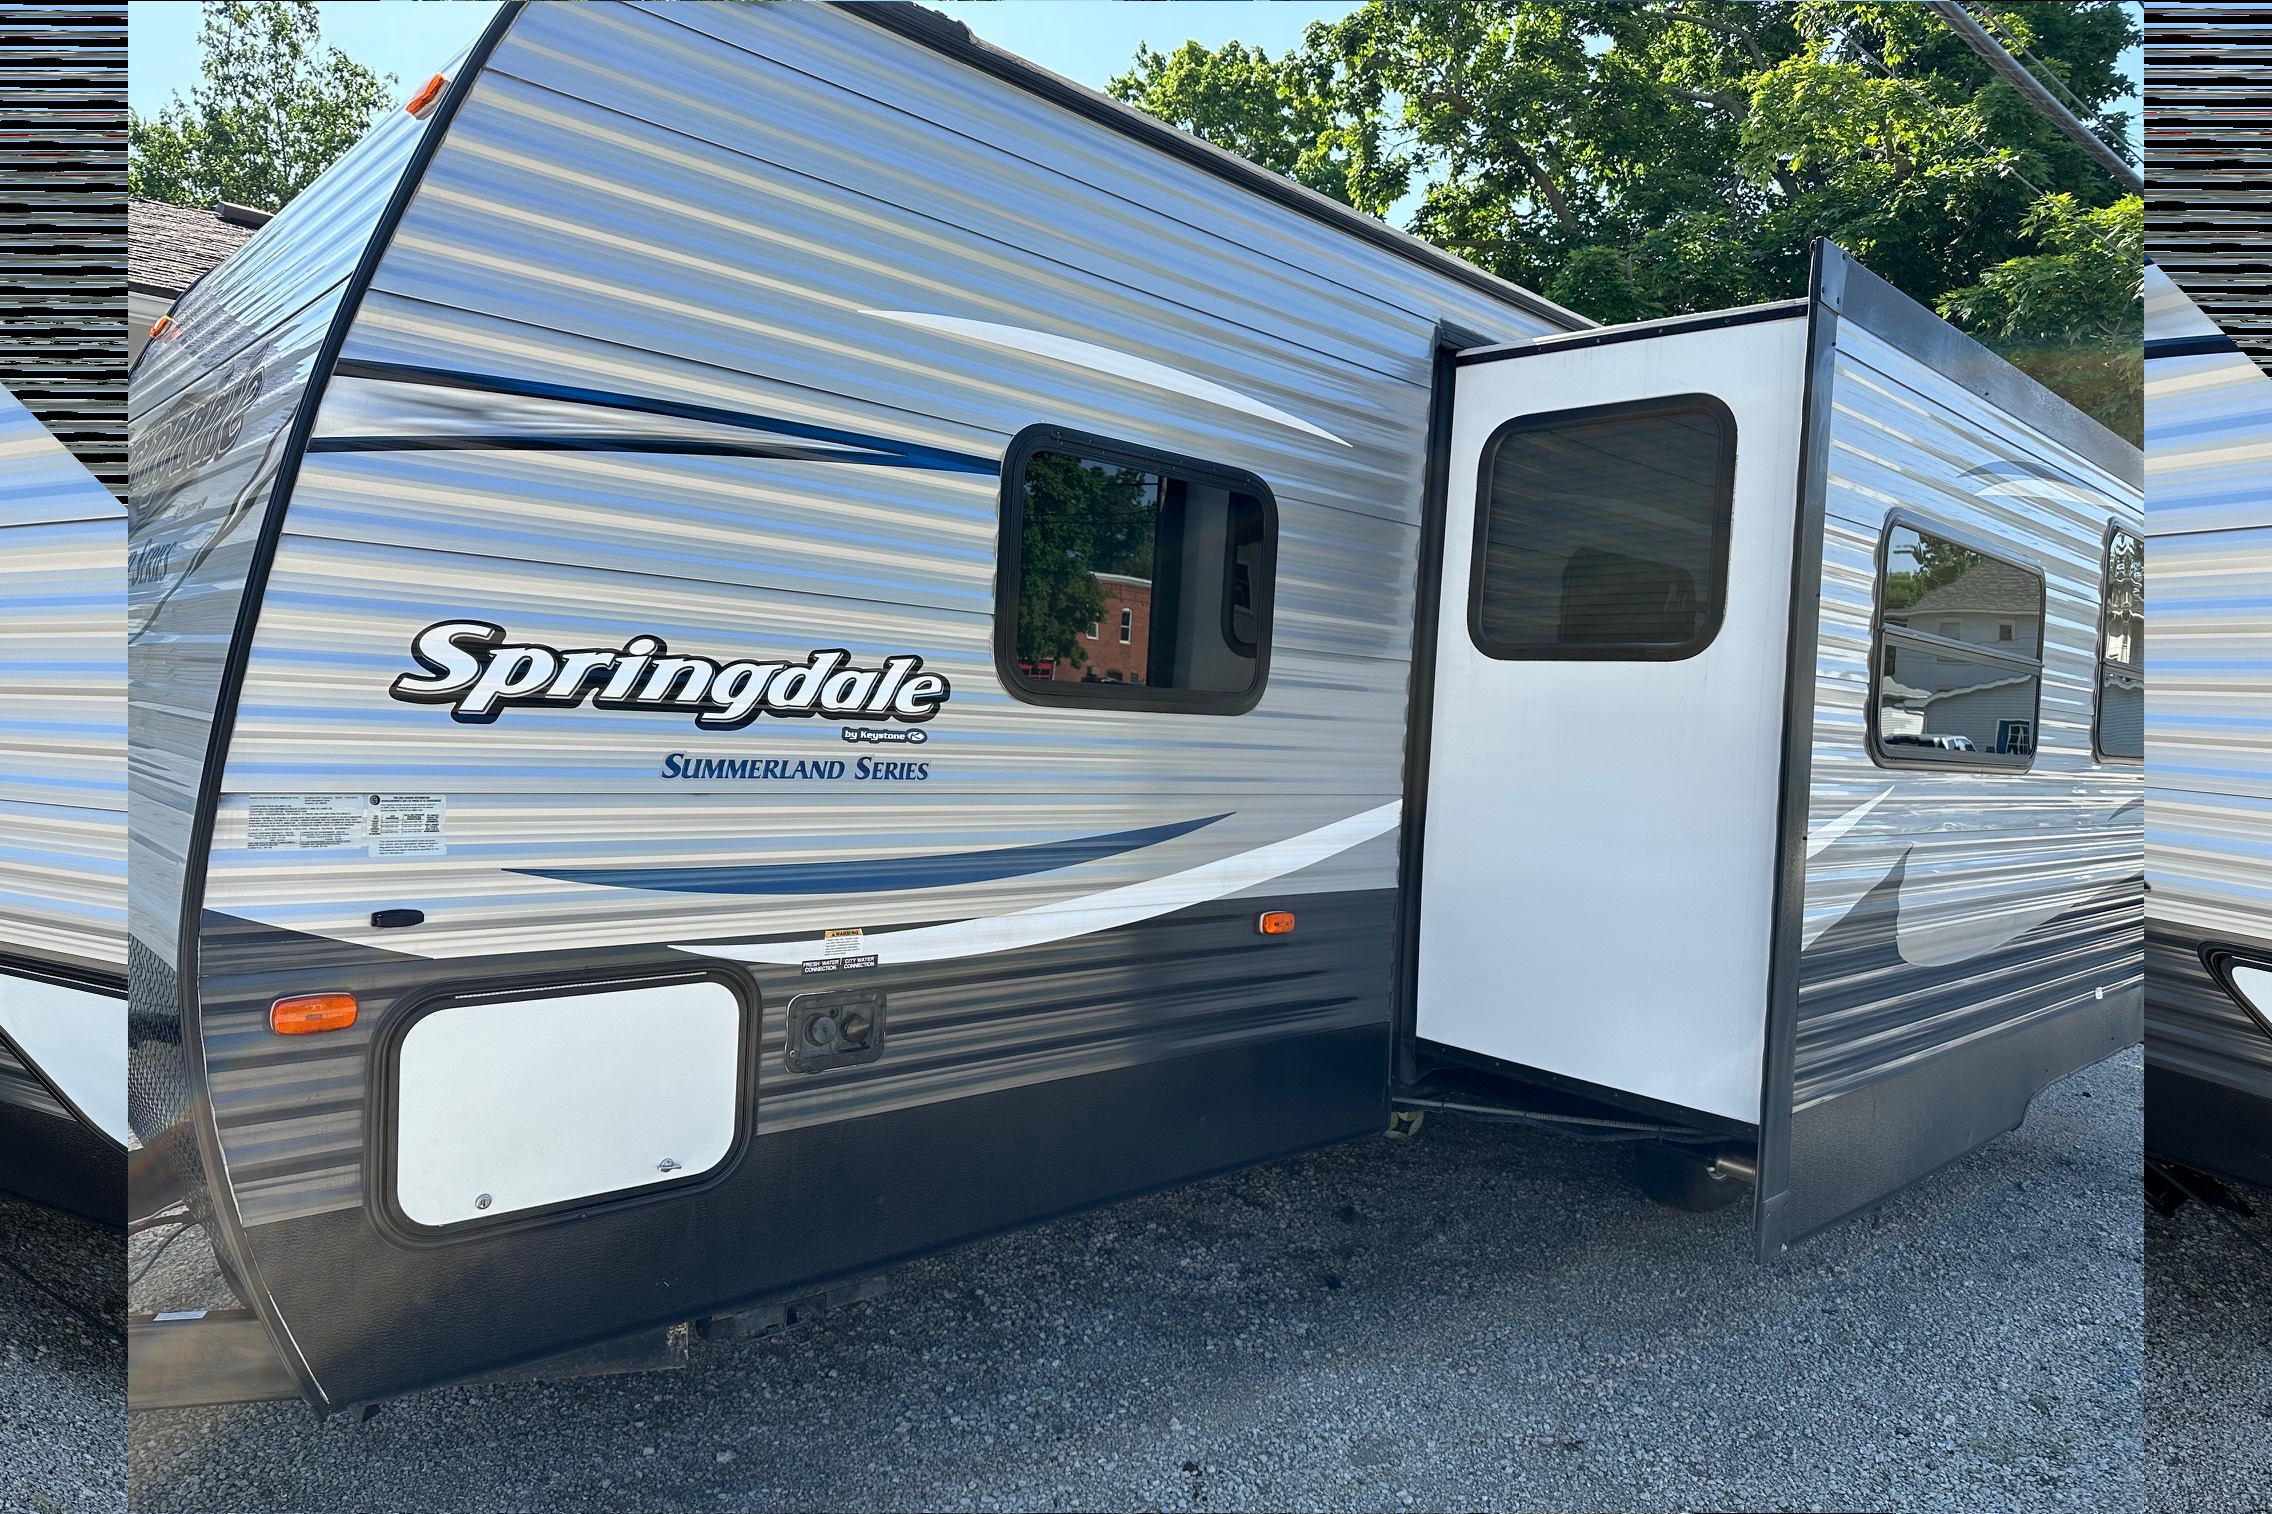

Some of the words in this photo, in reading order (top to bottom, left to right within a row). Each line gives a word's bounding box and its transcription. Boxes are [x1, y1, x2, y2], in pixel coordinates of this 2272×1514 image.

[393, 621, 947, 726] Springdale
[844, 730, 858, 740] by
[860, 731, 906, 741] Keystone
[661, 753, 846, 780] SUMMERLAND
[854, 756, 930, 781] SERIES
[805, 965, 837, 973] CONNECTION
[844, 961, 875, 969] CONNECTION
